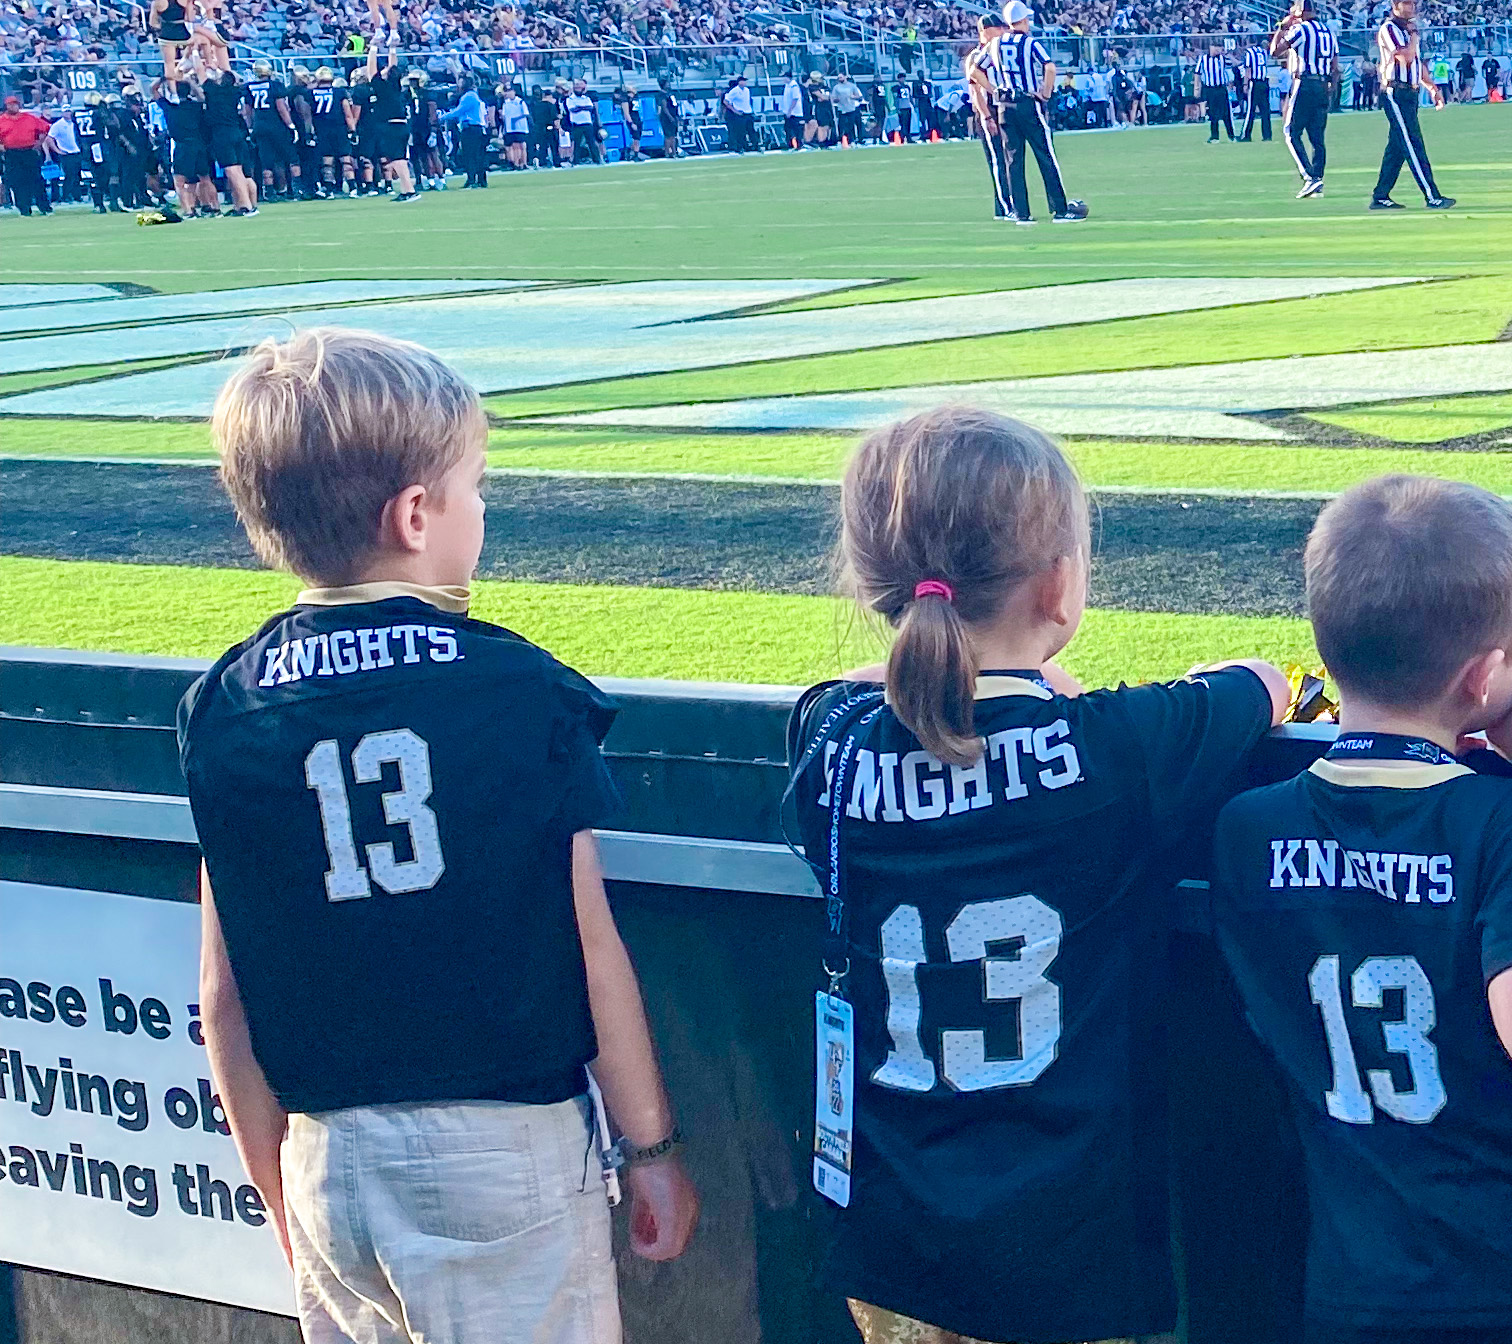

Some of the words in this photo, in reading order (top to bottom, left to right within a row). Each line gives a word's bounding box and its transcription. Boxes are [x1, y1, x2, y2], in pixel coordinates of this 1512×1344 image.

[68, 71, 97, 90] 109
[496, 58, 516, 75] 110
[1000, 45, 1018, 72] R
[251, 89, 271, 109] 72
[314, 94, 334, 114] 77
[258, 624, 462, 687] KNIGHTS
[304, 727, 447, 903] 13
[1269, 838, 1455, 904] KNIGHTS
[98, 977, 172, 1040] be
[870, 893, 1064, 1093] 13
[1307, 954, 1449, 1126] 13
[171, 1163, 268, 1227] the
